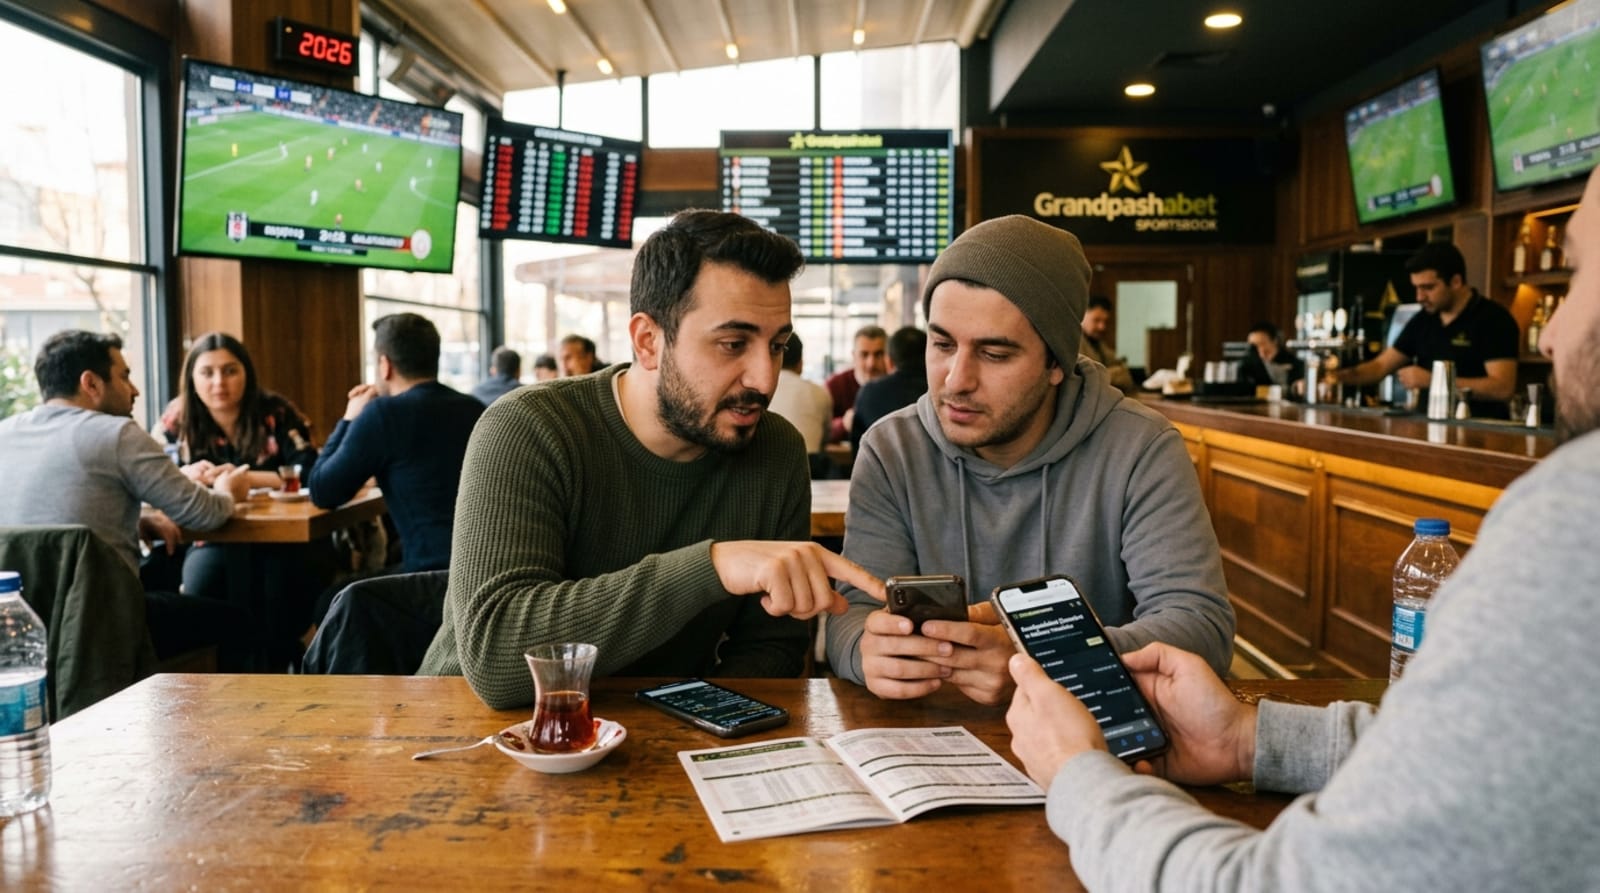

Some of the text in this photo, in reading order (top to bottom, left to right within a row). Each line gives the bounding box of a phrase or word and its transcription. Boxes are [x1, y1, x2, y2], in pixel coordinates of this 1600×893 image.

[299, 32, 352, 65] 2026
[1034, 192, 1217, 222] Grandpashabet
[1135, 218, 1217, 232] SPORTSBOOK
